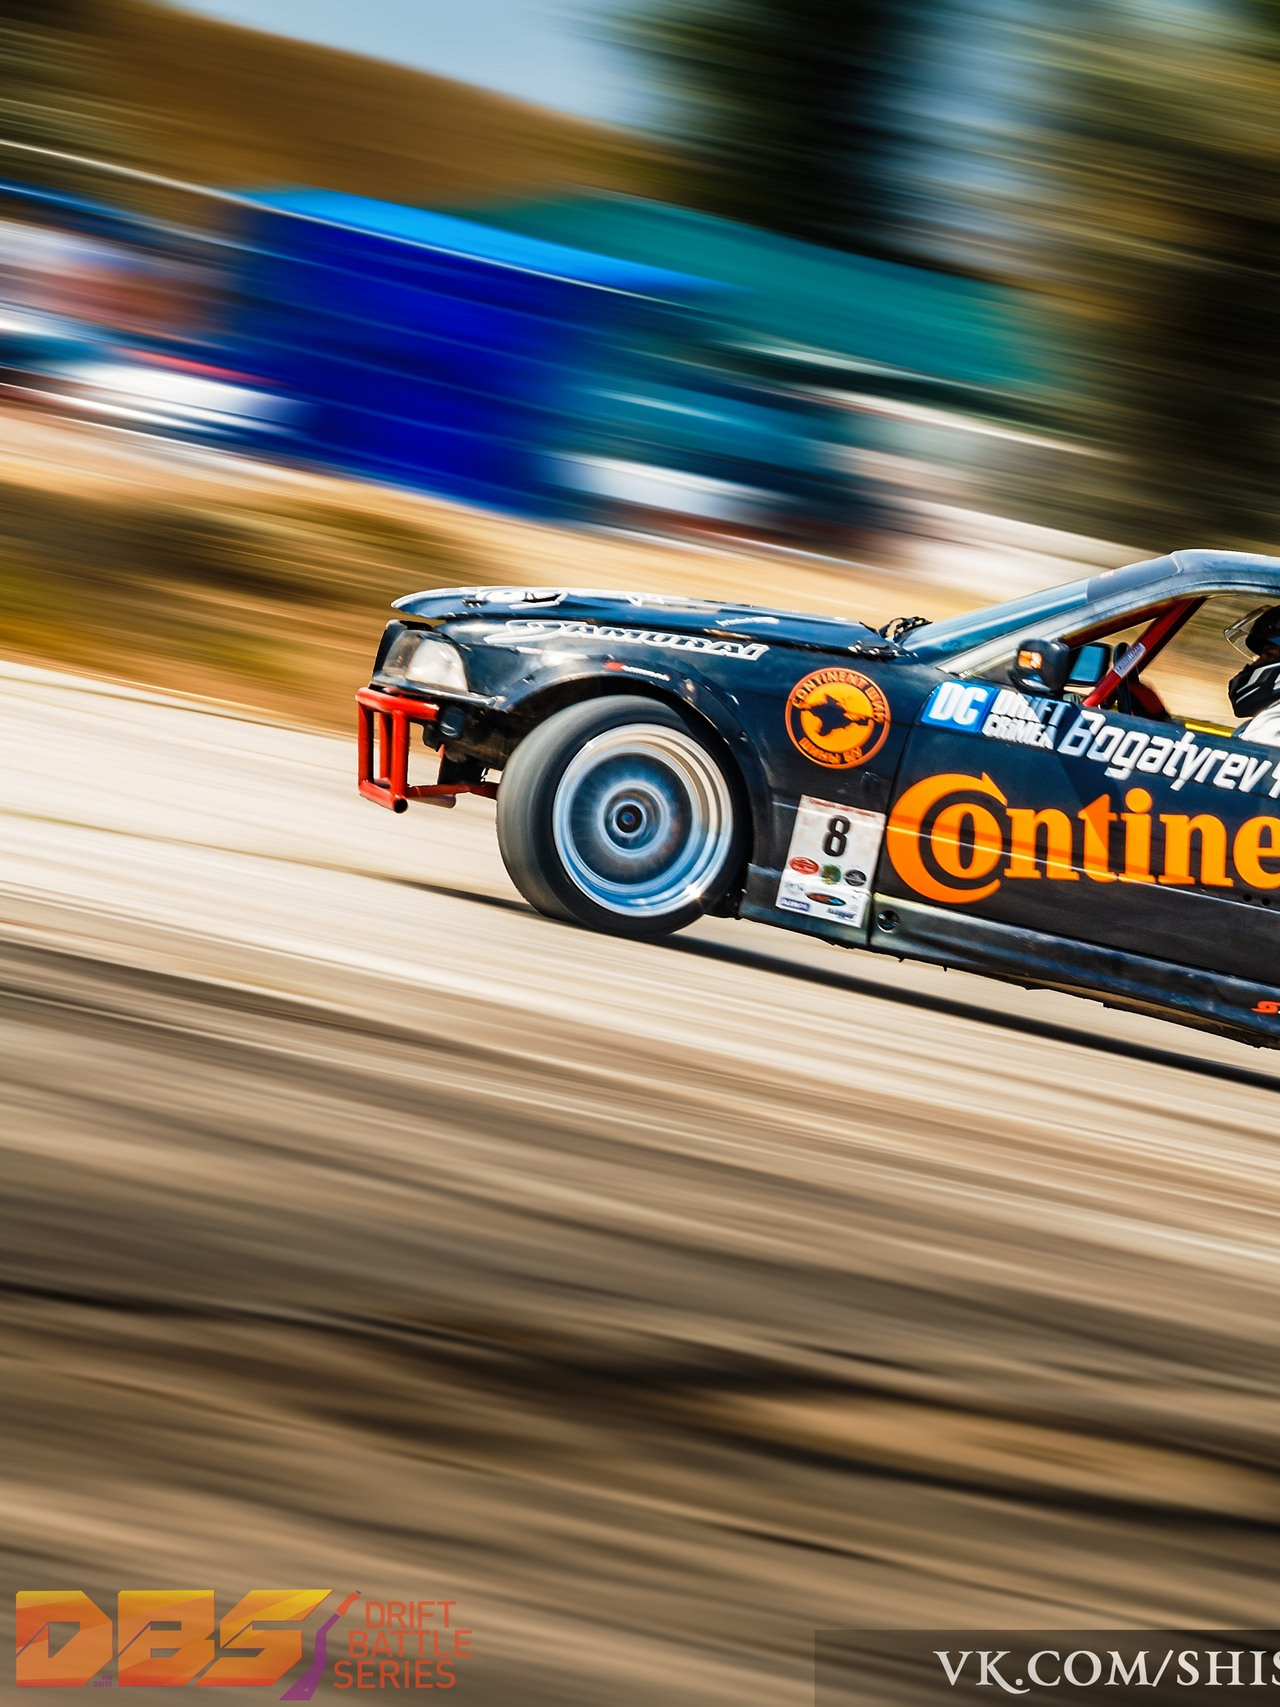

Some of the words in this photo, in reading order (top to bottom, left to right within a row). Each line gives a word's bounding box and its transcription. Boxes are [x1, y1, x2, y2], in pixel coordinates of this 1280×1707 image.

[928, 681, 988, 725] DC
[1057, 710, 1272, 793] Bogatyrev
[822, 814, 851, 857] 8
